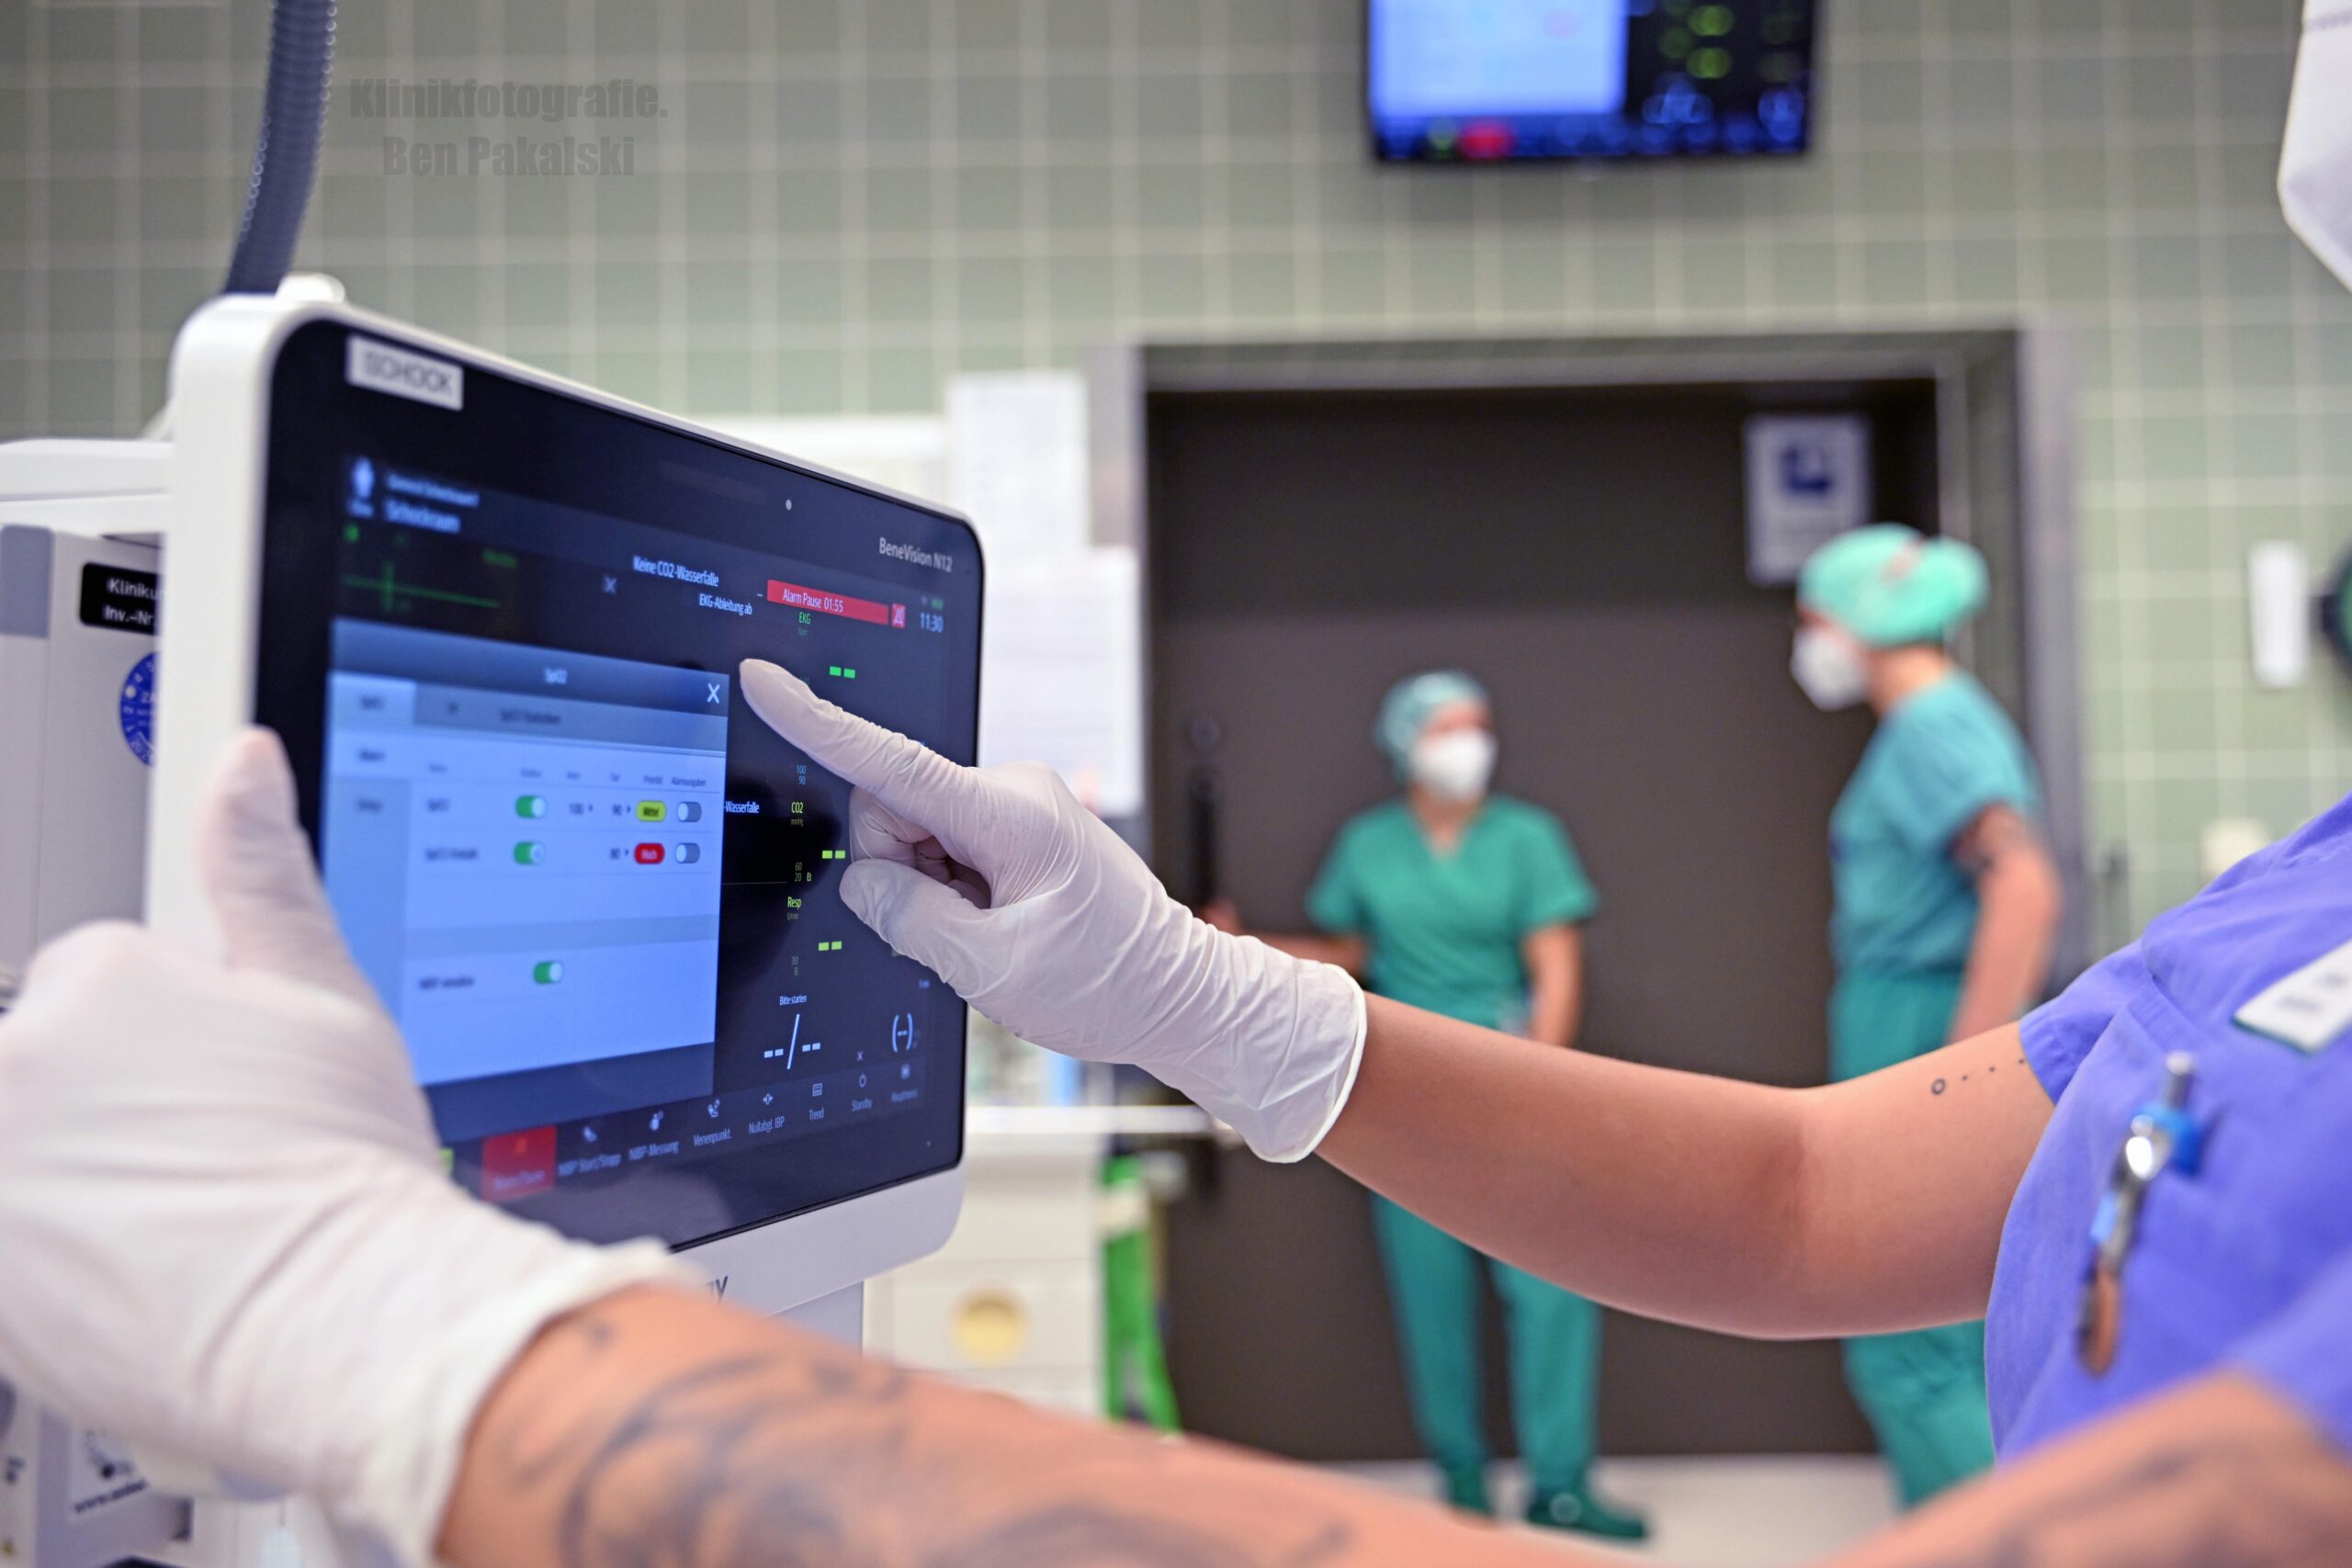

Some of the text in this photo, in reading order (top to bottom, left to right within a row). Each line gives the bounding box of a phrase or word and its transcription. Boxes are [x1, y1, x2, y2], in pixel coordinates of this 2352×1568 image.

[879, 536, 953, 572] BeneVision N12
[634, 555, 719, 588] Keine CO2-Wasserfalle
[107, 578, 162, 601] Kliniku
[699, 592, 753, 616] EKG-Ableitung ab
[783, 588, 843, 614] Alarm Pause 01:55
[798, 612, 811, 626] EKG
[921, 611, 944, 633] 11:30
[796, 764, 807, 775] 100
[798, 774, 806, 786] 90
[791, 801, 804, 814] CO2
[795, 862, 803, 872] 60
[794, 874, 802, 883] 20
[787, 896, 802, 909] Resp
[809, 1107, 825, 1121] Trend
[775, 1115, 786, 1129] IBP
